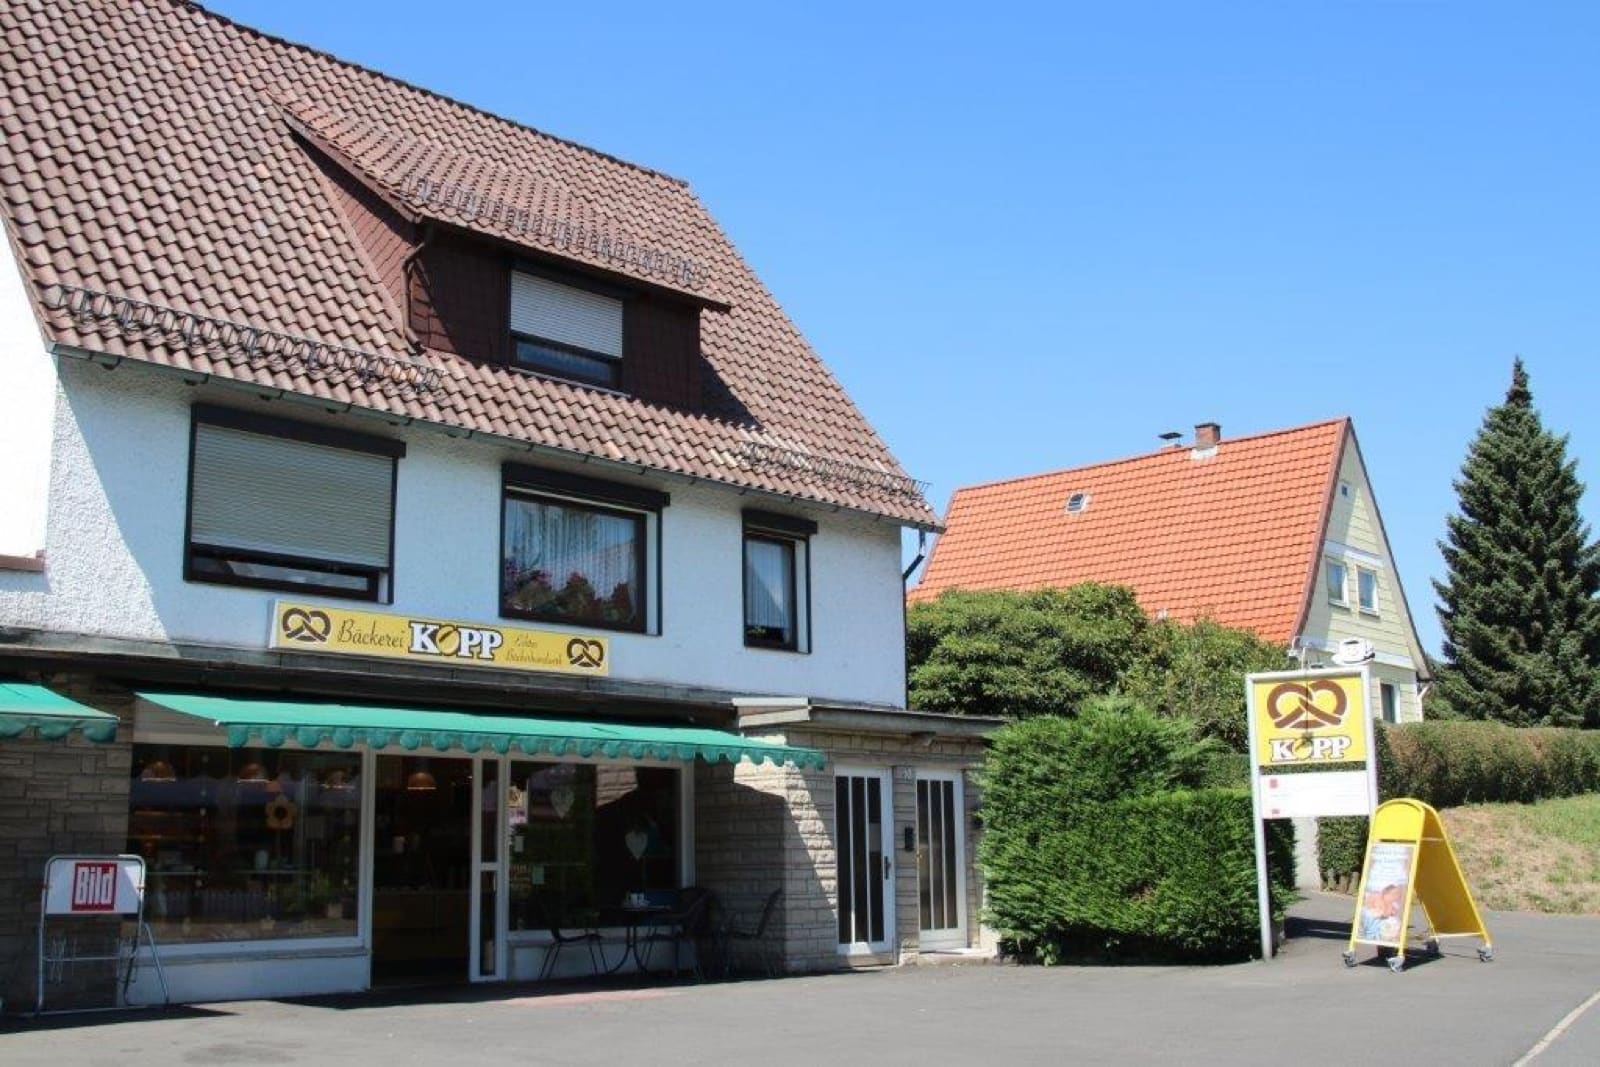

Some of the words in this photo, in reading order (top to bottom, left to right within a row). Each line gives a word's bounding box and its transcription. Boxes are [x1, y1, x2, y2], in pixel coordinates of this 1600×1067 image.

[337, 618, 405, 648] Bäckerei
[408, 620, 503, 660] KOPP
[1269, 735, 1351, 762] KOPP
